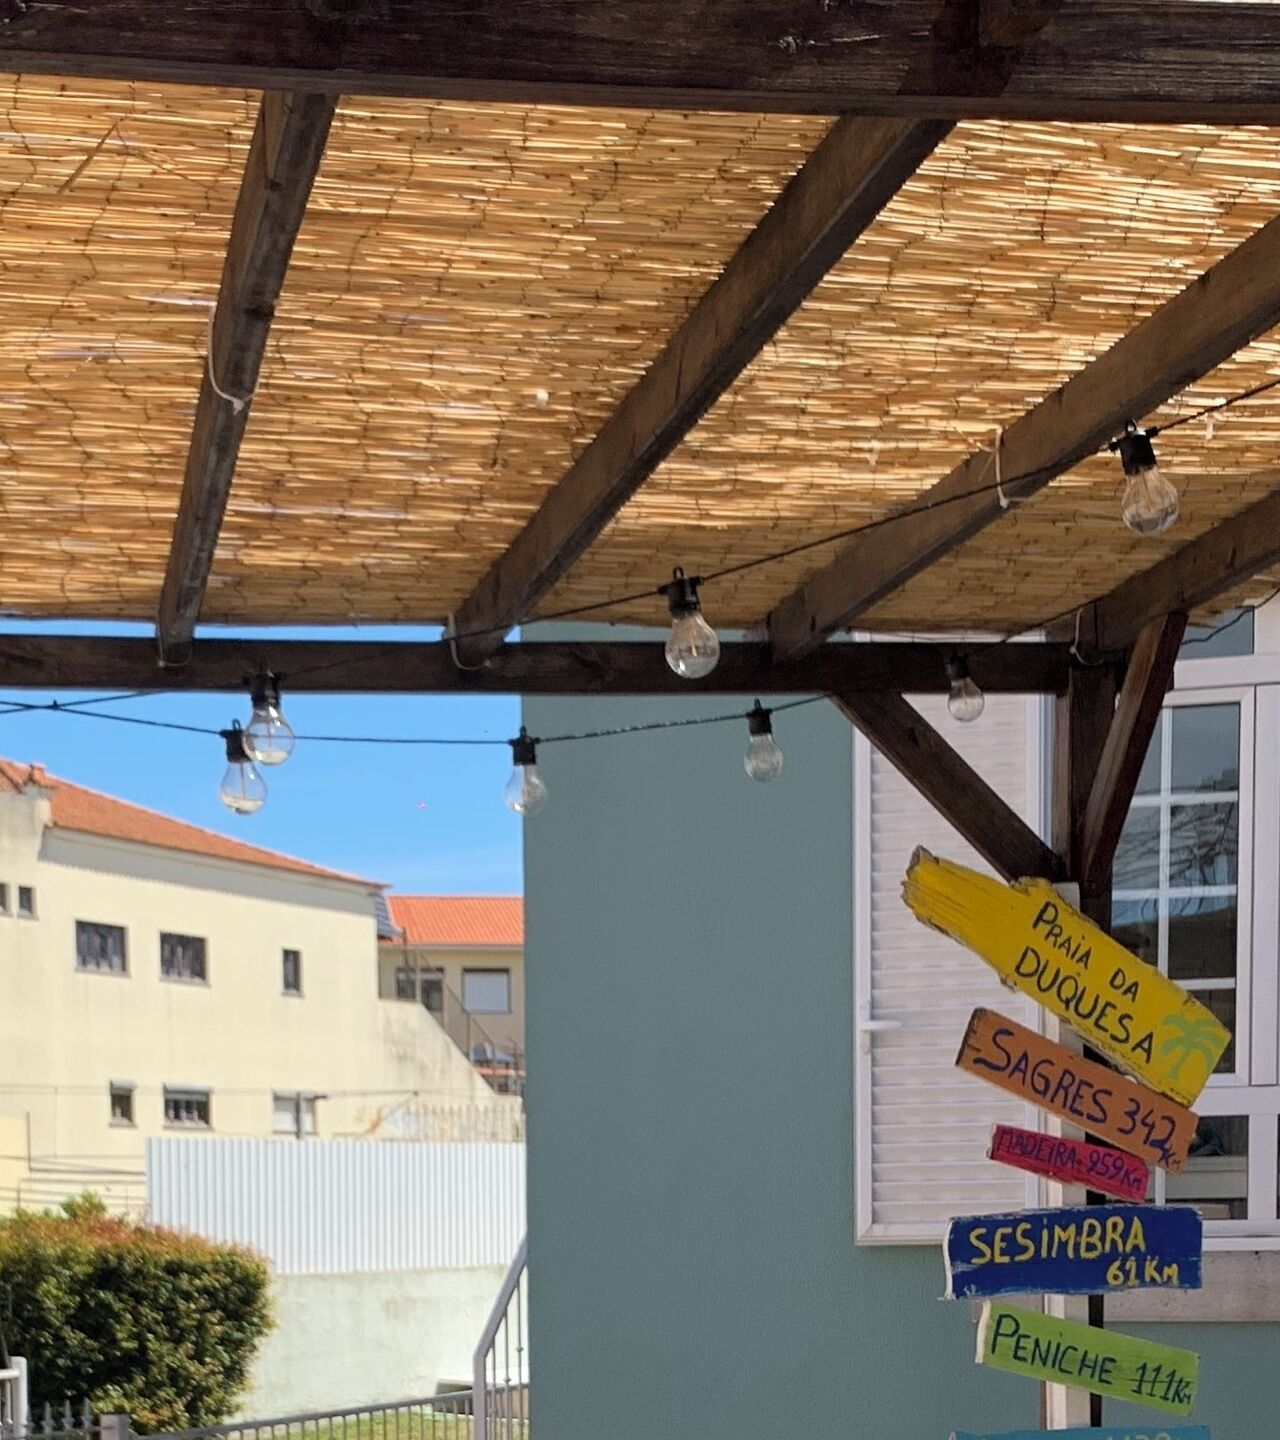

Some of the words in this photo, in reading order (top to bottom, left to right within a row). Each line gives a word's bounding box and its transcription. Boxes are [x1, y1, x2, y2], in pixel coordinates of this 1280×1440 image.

[1013, 945, 1156, 1065] DUQUESA
[1108, 967, 1141, 1003] DA
[972, 1028, 1110, 1125] SAGRES
[969, 1215, 1147, 1265] SESIMBRA
[990, 1313, 1118, 1384] PENICHE
